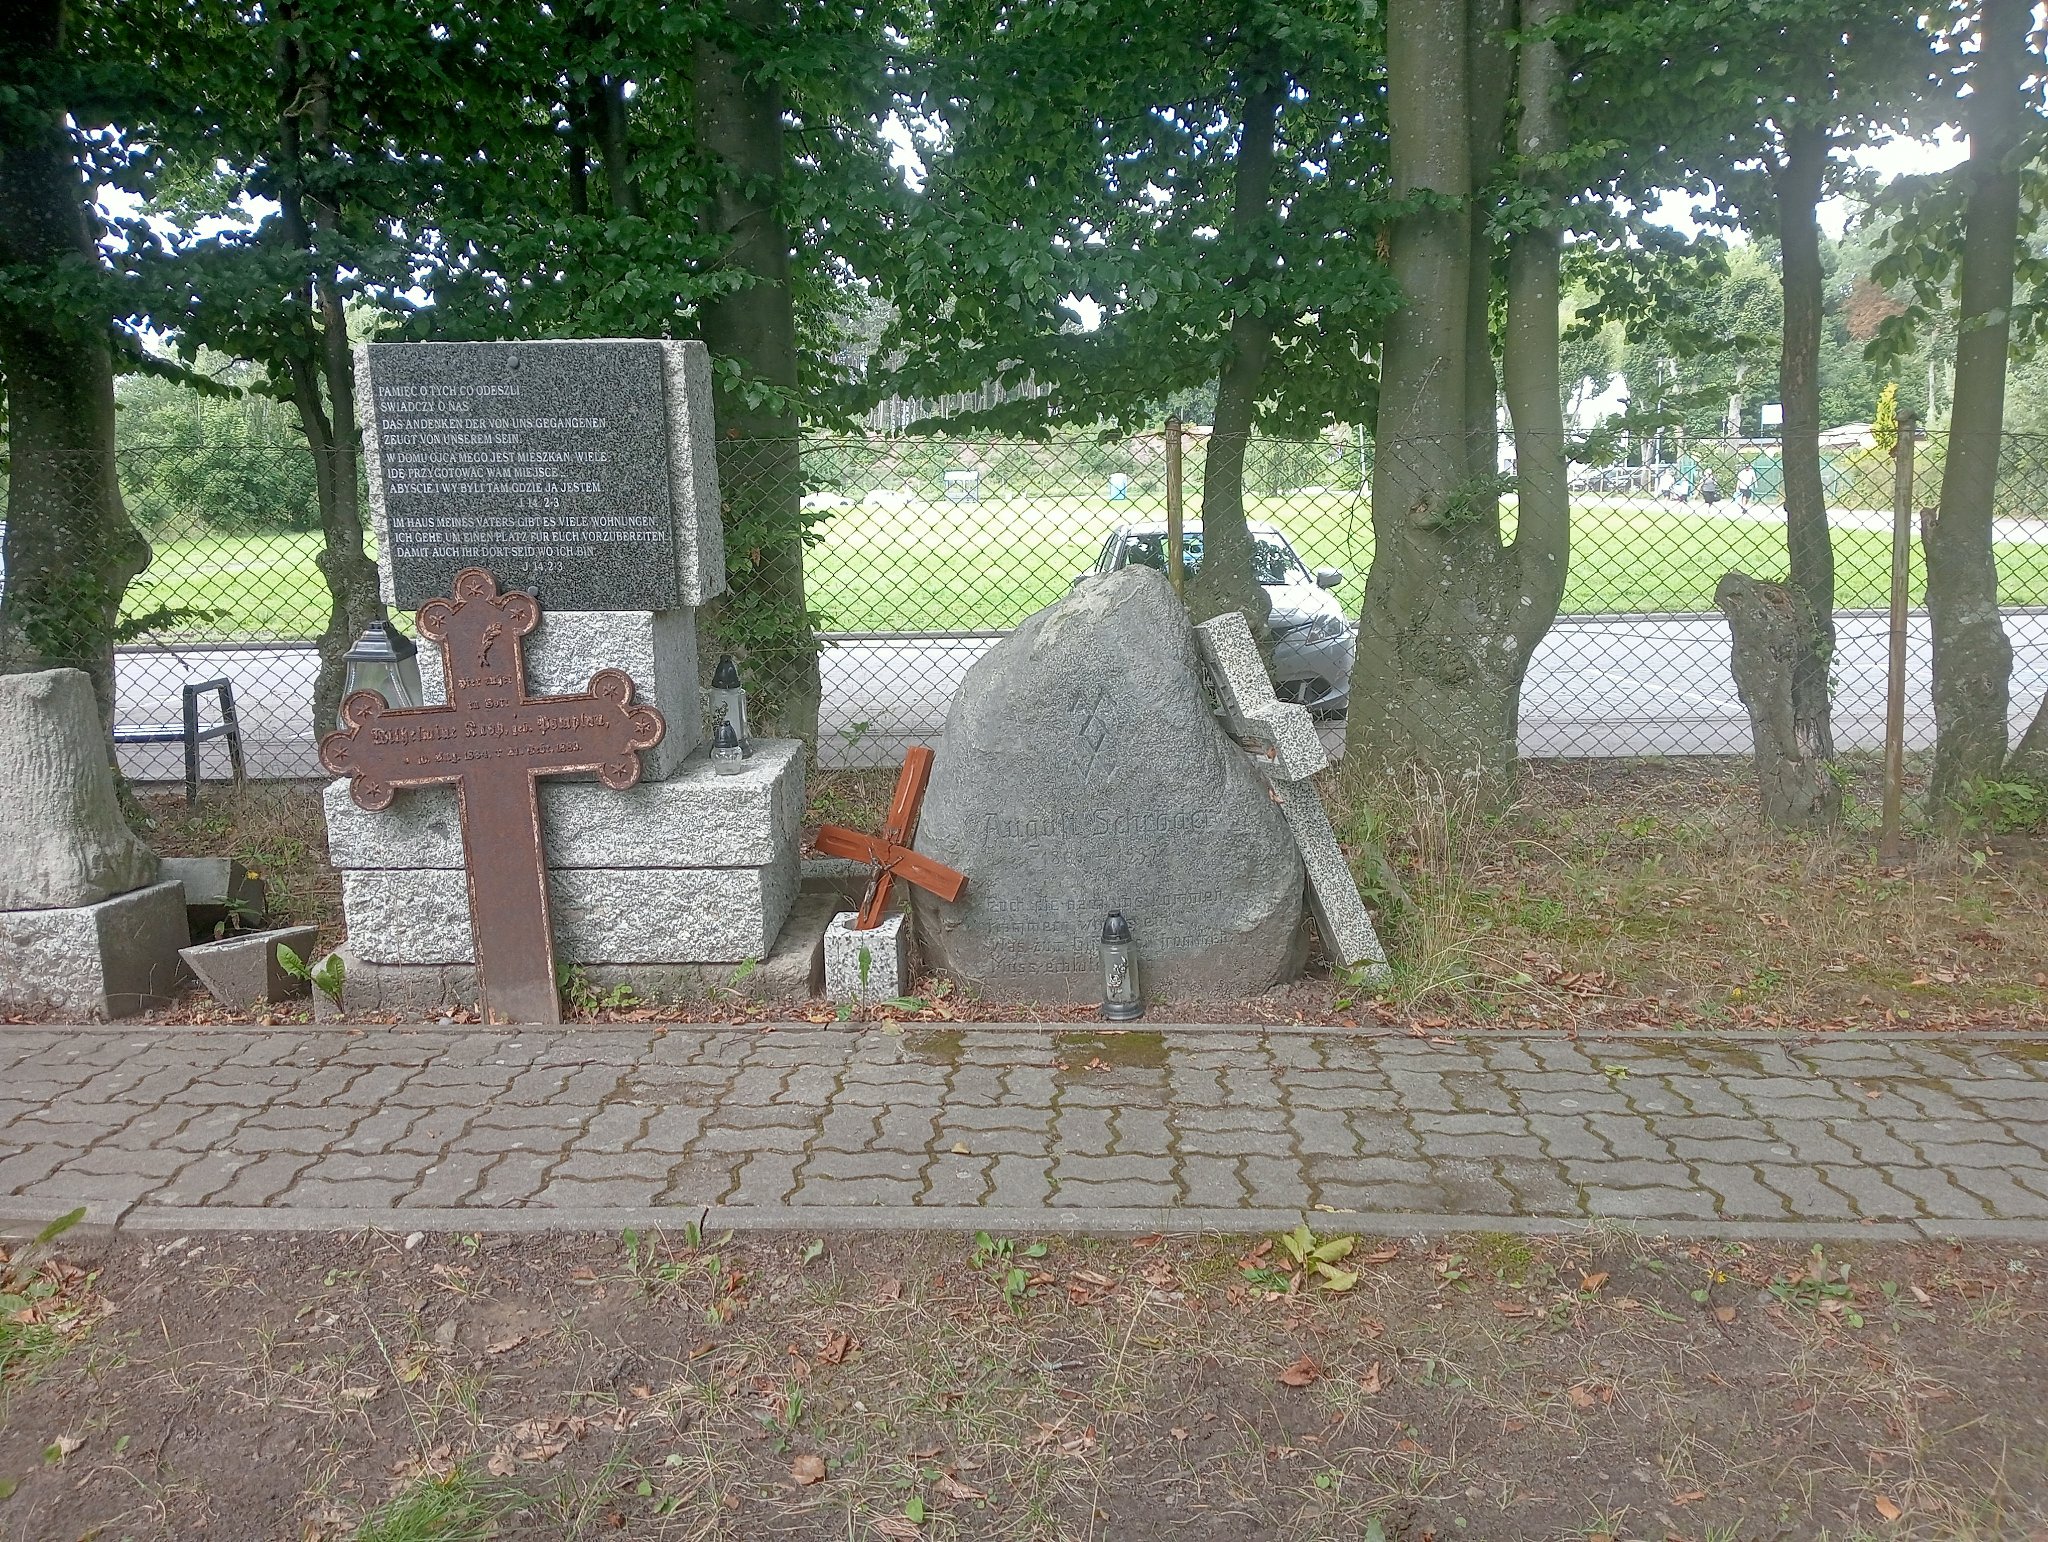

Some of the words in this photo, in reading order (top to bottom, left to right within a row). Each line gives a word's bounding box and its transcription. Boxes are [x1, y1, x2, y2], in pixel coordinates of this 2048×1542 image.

[420, 386, 427, 396] O
[430, 386, 456, 396] TYCH
[460, 386, 473, 396] CO
[438, 401, 445, 412] O
[382, 420, 402, 430] DAS
[406, 419, 463, 429] ANDENKEN
[465, 419, 486, 429] DER
[488, 418, 509, 428] VON
[512, 418, 532, 428] UNS
[535, 418, 606, 428] GEGANGENEN
[384, 434, 418, 444] ZEUGT
[420, 434, 440, 444] VON
[444, 434, 492, 444] UNSEREM
[386, 453, 395, 463] W
[398, 453, 427, 463] DOMU
[429, 452, 456, 463] OJCA
[459, 452, 488, 462] MEGO
[490, 452, 514, 463] JEST
[388, 468, 405, 479] IDĘ
[486, 468, 511, 478] WAM
[436, 483, 440, 493] I
[442, 483, 458, 493] WY
[460, 483, 484, 493] BYLI
[487, 483, 509, 493] TAM
[512, 482, 542, 493] GDZIE
[545, 482, 558, 493] JA
[393, 518, 405, 528] IM
[407, 518, 435, 528] HAUS
[436, 518, 475, 527] MEINES
[477, 517, 515, 527] VATERS
[517, 517, 540, 527] GIBT
[543, 517, 556, 526] ES
[559, 516, 589, 526] VIELE
[395, 533, 413, 543] ICH
[446, 533, 461, 542] UM
[464, 532, 493, 542] EINEN
[496, 532, 527, 542] PLATZ
[552, 531, 580, 542] EUCH
[397, 548, 429, 558] DAMIT
[432, 547, 459, 557] AUCH
[462, 547, 482, 557] IHR
[482, 547, 510, 557] DORT
[538, 547, 553, 556] WO
[556, 546, 573, 556] ICH
[521, 561, 529, 571] J
